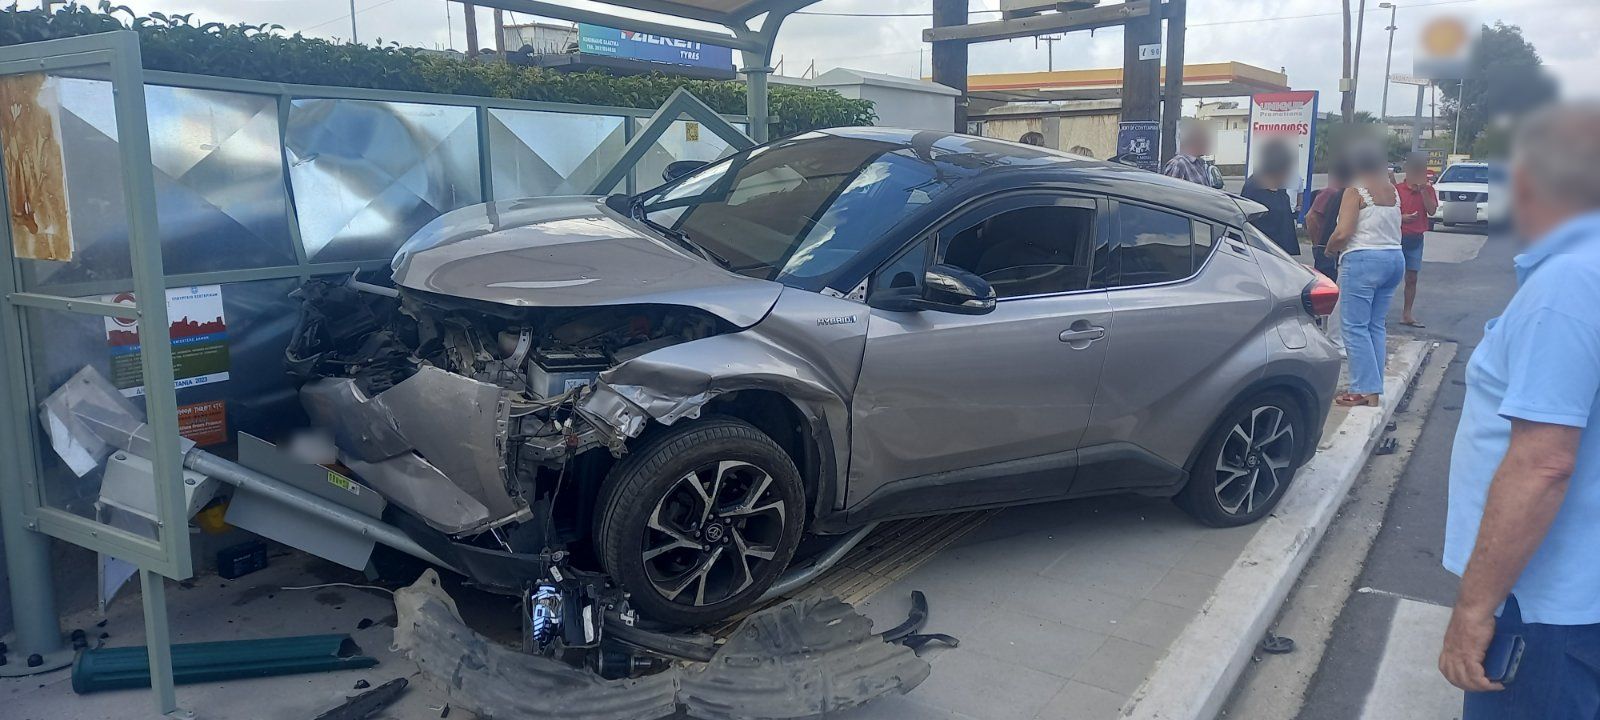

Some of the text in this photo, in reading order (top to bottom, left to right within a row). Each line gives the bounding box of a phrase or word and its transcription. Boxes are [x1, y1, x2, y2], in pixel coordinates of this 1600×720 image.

[680, 50, 700, 60] TYRES
[1259, 101, 1303, 111] UNIQUE
[817, 316, 851, 326] HYBRID
